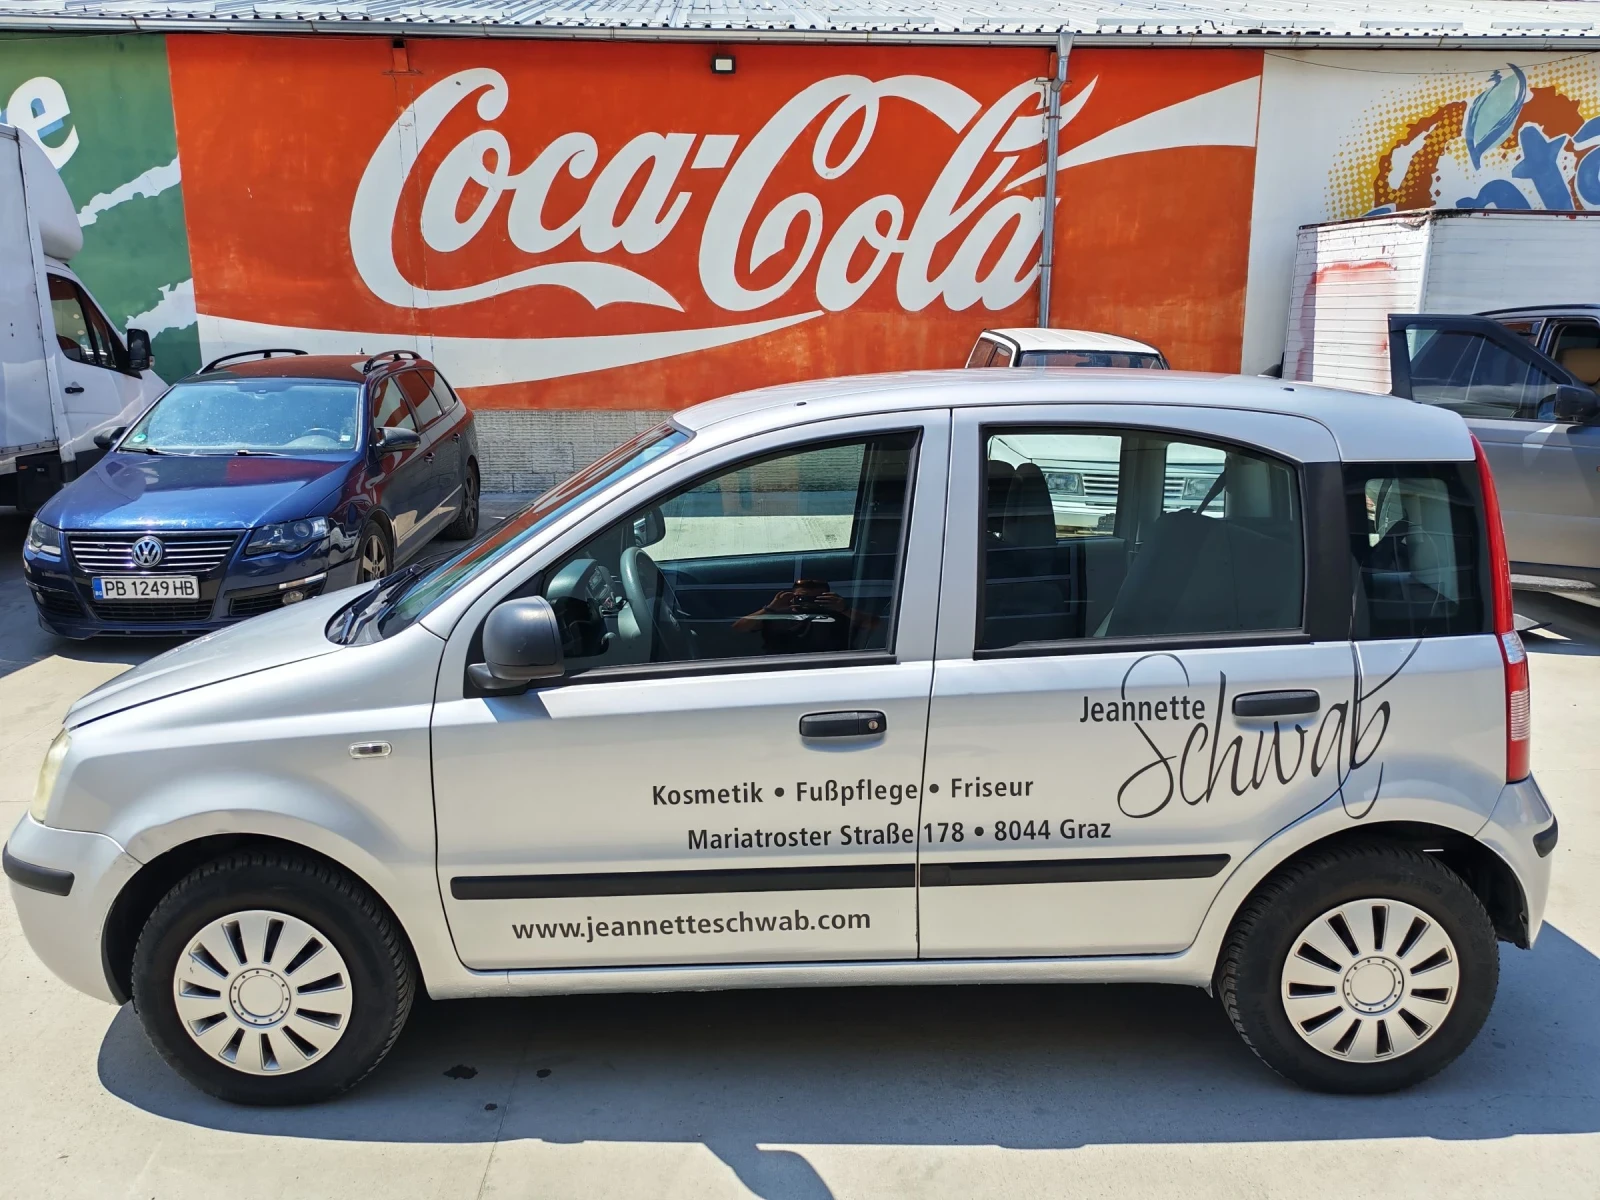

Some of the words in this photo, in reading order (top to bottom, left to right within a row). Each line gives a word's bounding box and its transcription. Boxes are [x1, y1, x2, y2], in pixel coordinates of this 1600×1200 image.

[350, 66, 1098, 312] Coca-Cola
[104, 580, 127, 596] PB
[131, 580, 170, 596] 1249
[173, 580, 195, 596] HB
[1079, 696, 1206, 723] Jeannette
[1117, 652, 1420, 820] Schwab
[652, 781, 764, 806] Kosmetik
[796, 778, 919, 807] Fußpflege
[951, 776, 1034, 799] Friseur
[688, 827, 832, 850] Mariatroster
[840, 821, 914, 846] Straße
[923, 821, 965, 844] 178
[994, 819, 1051, 842] 8044
[1059, 818, 1112, 840] Graz
[511, 909, 871, 943] www.jeannetteschwab.com
